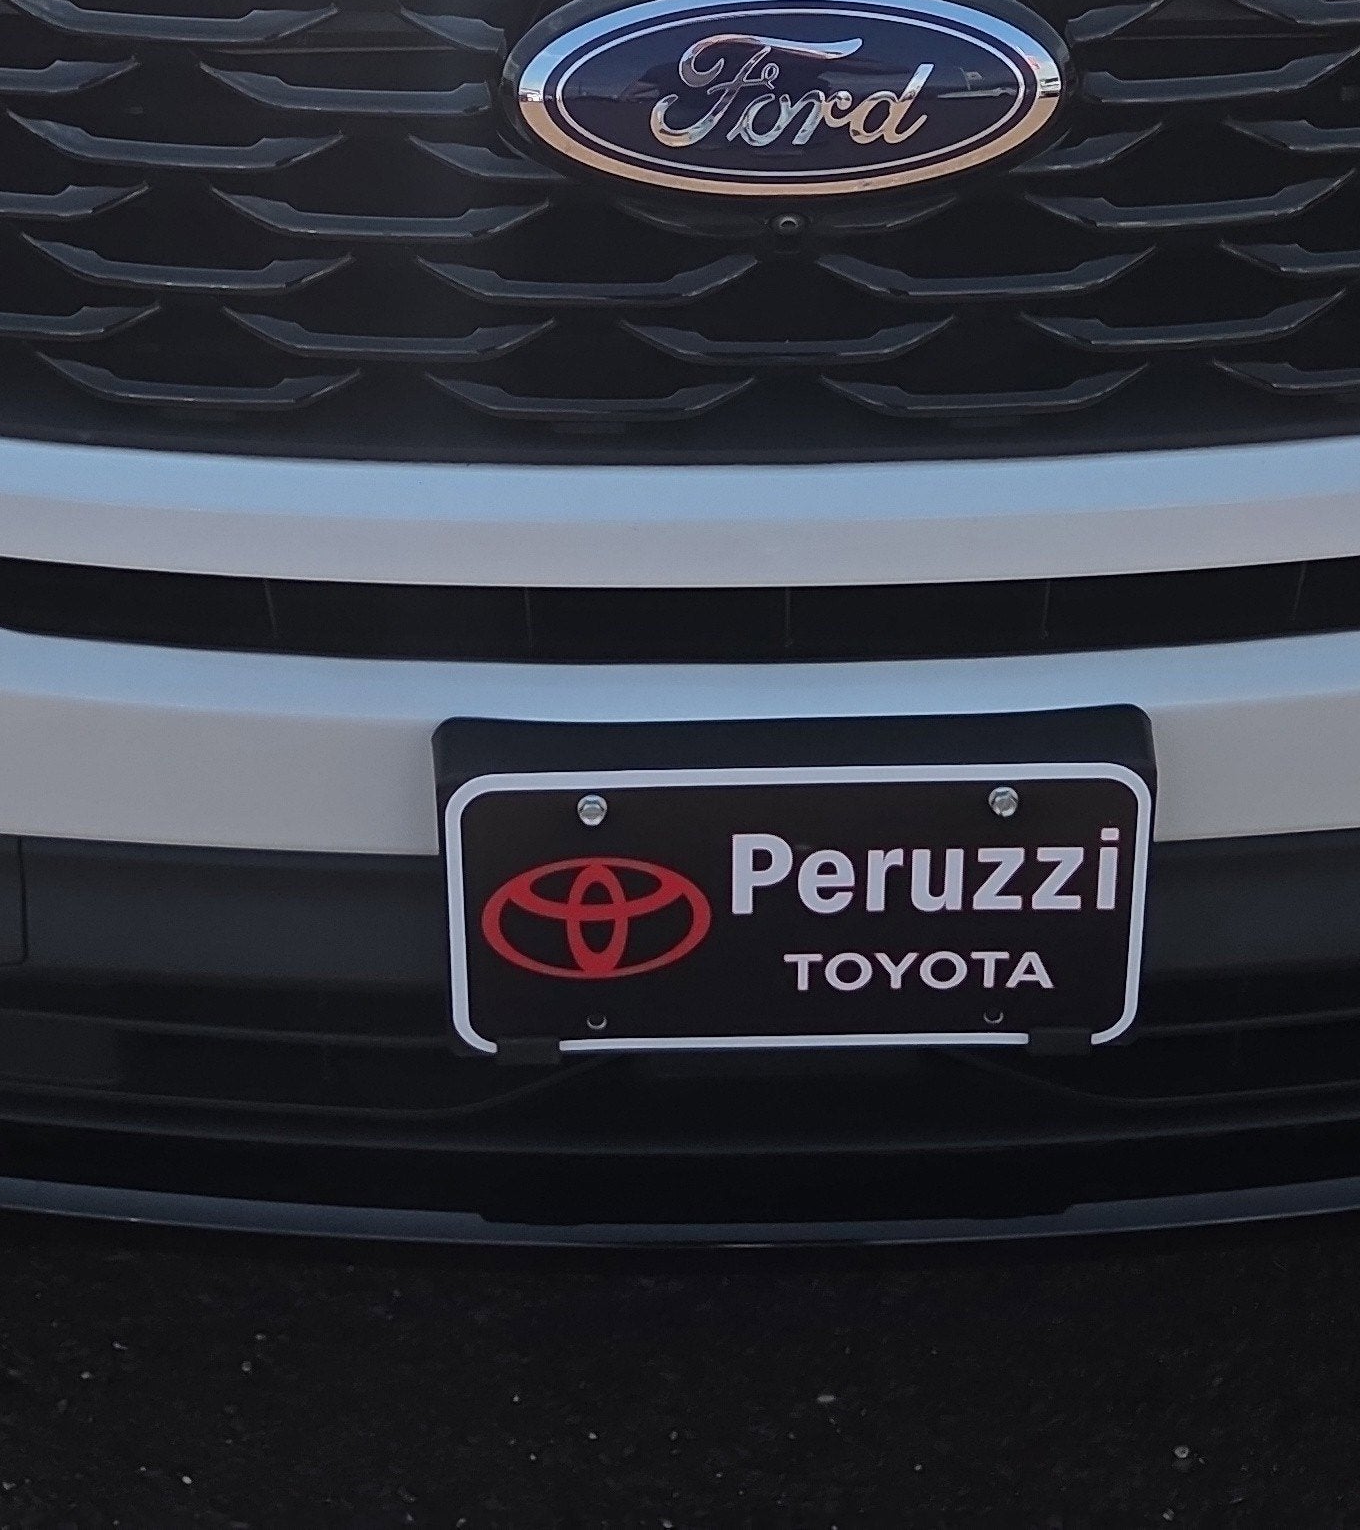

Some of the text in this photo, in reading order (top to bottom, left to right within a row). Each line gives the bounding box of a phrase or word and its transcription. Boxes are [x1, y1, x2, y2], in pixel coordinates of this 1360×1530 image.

[649, 33, 935, 148] Ford
[730, 826, 1121, 916] Peruzzi
[783, 950, 1055, 992] TOYOTA
